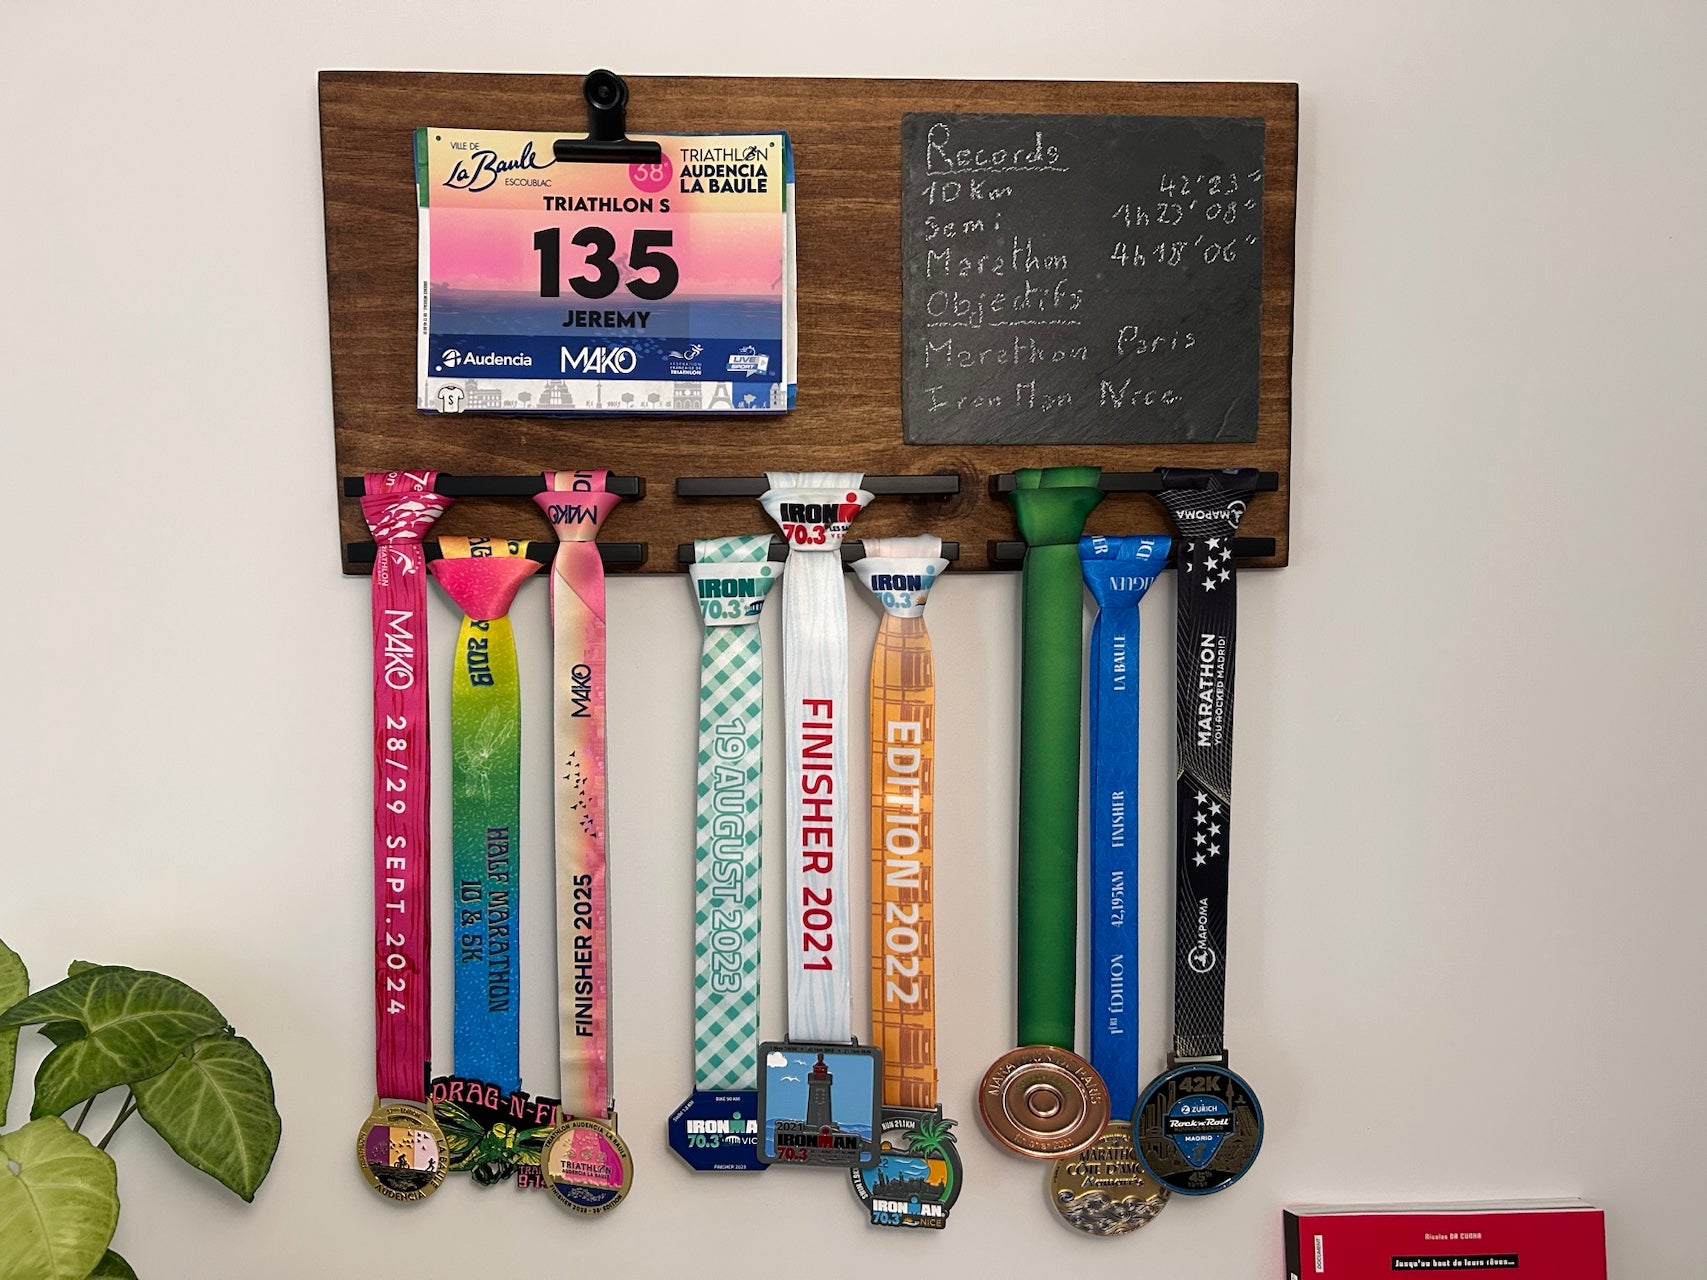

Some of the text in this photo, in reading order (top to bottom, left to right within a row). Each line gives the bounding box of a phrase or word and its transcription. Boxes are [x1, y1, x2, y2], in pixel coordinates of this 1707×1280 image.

[450, 142, 480, 150] VILLE DE
[680, 146, 768, 162] TRIATHLON
[927, 123, 1060, 171] Records
[442, 141, 556, 192] La Baule
[680, 164, 767, 178] AUDENCIA
[505, 178, 552, 187] ESCOUBLAC
[680, 179, 768, 193] LA BAULE
[543, 196, 670, 213] TRIATHLON S
[533, 226, 680, 300] 135
[926, 236, 1068, 278] Marathon
[562, 310, 651, 329] JEREMY
[925, 325, 1196, 368] Marathon Paris
[463, 352, 533, 367] Audencia
[561, 347, 637, 374] MAKO
[448, 395, 454, 405] S
[924, 385, 1002, 412] Iron
[1099, 378, 1184, 408] Nice
[548, 504, 598, 525] MAKO
[1176, 510, 1231, 520] MAPOMA
[783, 524, 826, 545] 70.3
[700, 599, 741, 619] 70.3
[384, 609, 414, 690] MAKO
[468, 637, 494, 687] 2019
[1113, 633, 1126, 690] LA BAULE
[571, 664, 592, 717] MAKO
[1197, 633, 1216, 747] MARATHON
[1214, 635, 1226, 746] YOU ROCKED MADRID!
[385, 715, 408, 814] 28/29
[1111, 790, 1124, 848] FINISHER
[802, 698, 833, 971] FINISHER 2021
[710, 718, 747, 994] 19 AUGUST 2023
[886, 720, 921, 1004] EDITION 2022
[487, 827, 510, 1014] HALF MARATHON
[1198, 897, 1209, 950] MAPOMA
[461, 934, 483, 964] 5K
[573, 874, 594, 1037] FINISHER 2025
[1180, 1076, 1221, 1093] 42K
[1191, 1105, 1218, 1113] ZURICH
[545, 1124, 570, 1148] TRIATHLON
[572, 1122, 604, 1133] AUDENCIA
[777, 1121, 803, 1132] 2021
[687, 1134, 720, 1148] 70.3
[777, 1128, 857, 1149] IRONMAN
[777, 1147, 808, 1161] 70.3
[561, 1160, 611, 1174] TRIATHLON
[375, 1184, 427, 1201] AUDENCIA
[872, 1196, 942, 1218] IRONMAN
[873, 1211, 900, 1225] 70.3
[920, 1217, 942, 1227] NICE
[1432, 1259, 1451, 1267] bout
[1453, 1259, 1462, 1267] de
[1464, 1258, 1484, 1267] leurs
